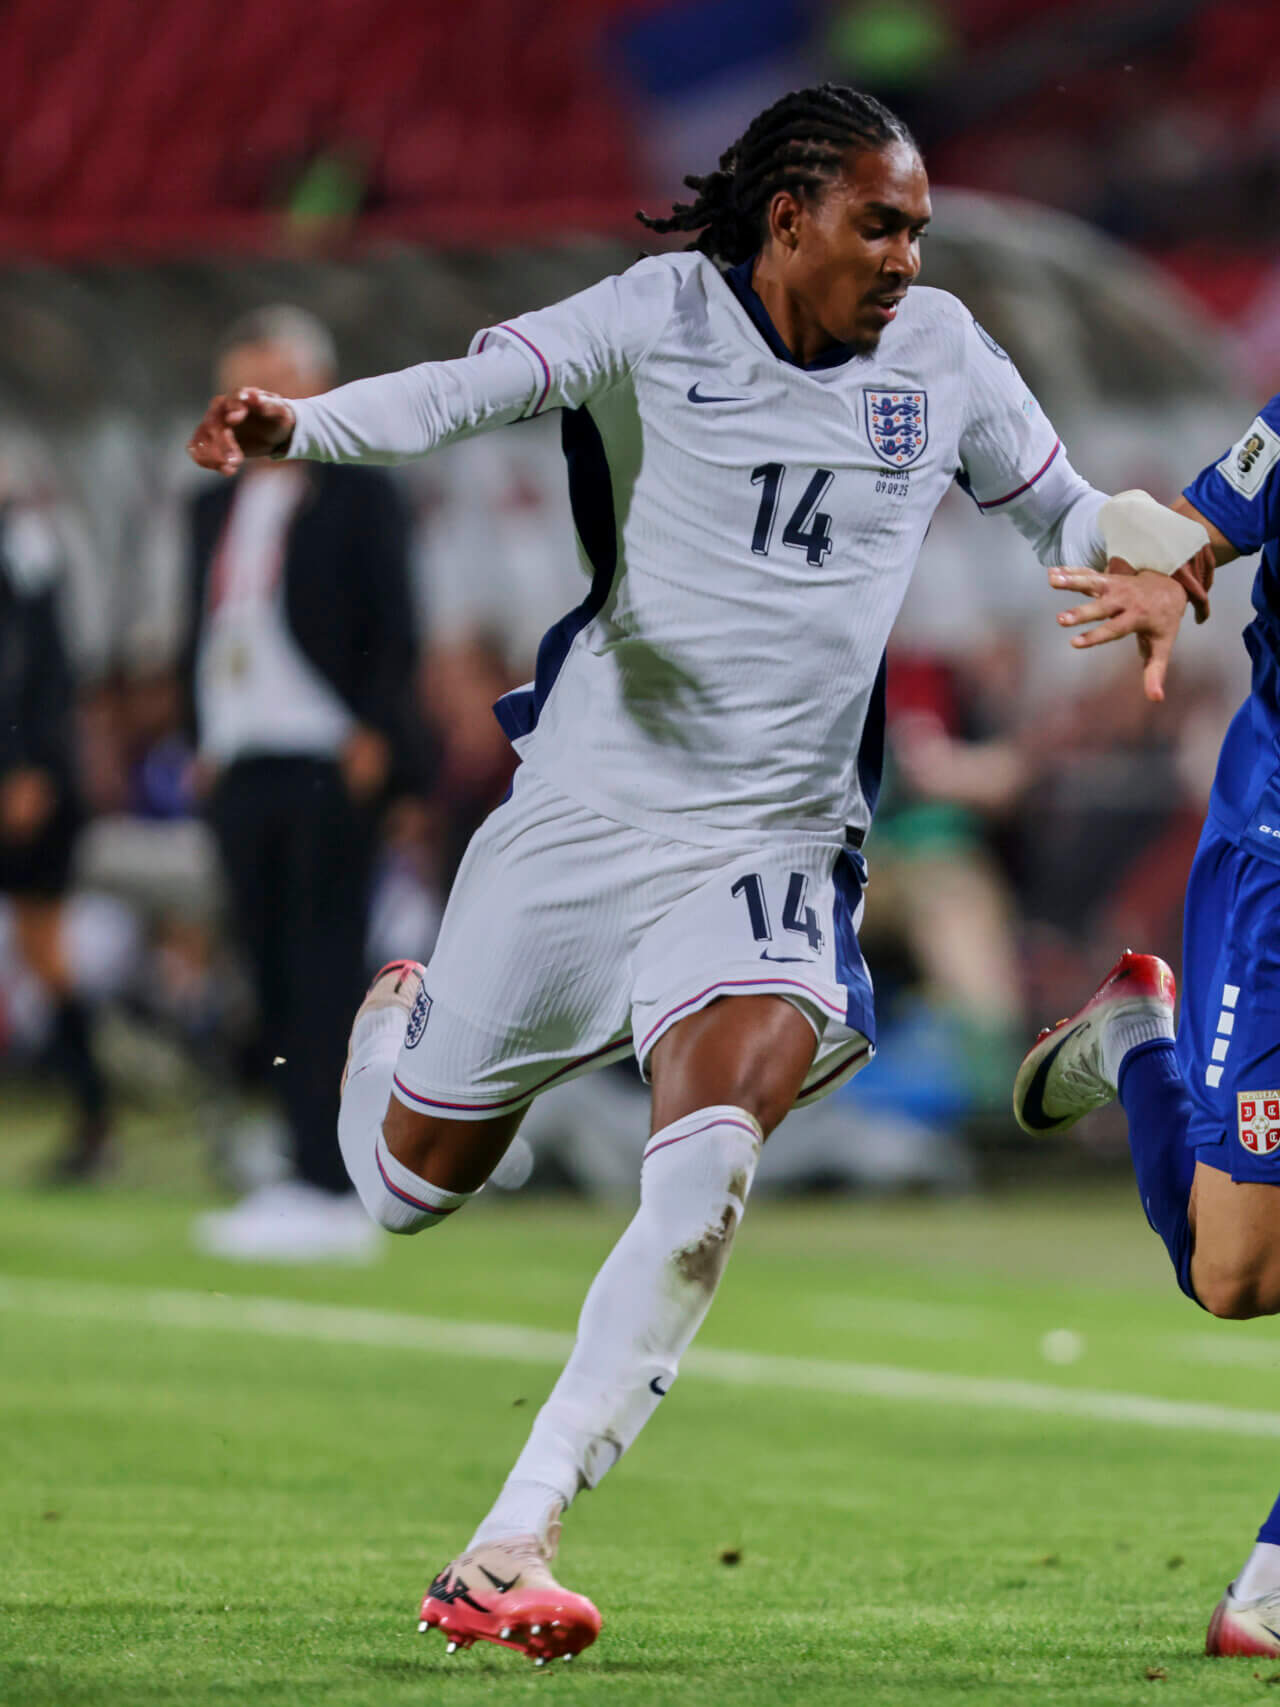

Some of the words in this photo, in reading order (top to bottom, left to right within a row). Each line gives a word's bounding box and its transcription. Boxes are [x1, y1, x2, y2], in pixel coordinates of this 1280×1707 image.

[751, 462, 835, 567] 14
[875, 480, 909, 496] 09.09.25
[731, 872, 825, 956] 14
